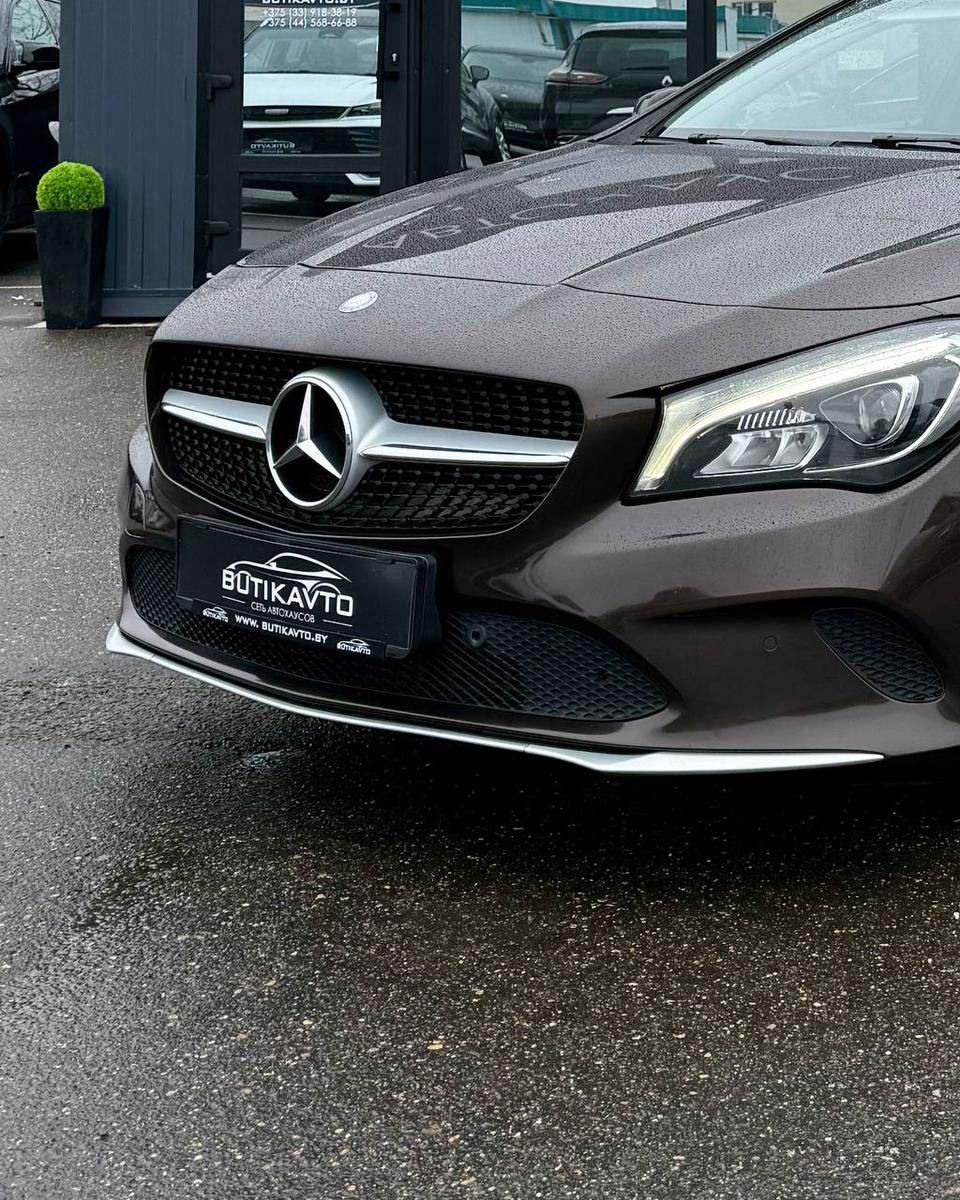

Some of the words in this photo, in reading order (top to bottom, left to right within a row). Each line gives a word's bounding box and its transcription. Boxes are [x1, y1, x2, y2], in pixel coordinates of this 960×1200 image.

[263, 8, 287, 17] +375
[289, 7, 307, 20] (33)
[310, 7, 357, 17] 918-38-19
[267, 18, 287, 27] 375
[289, 17, 307, 29] (44)
[310, 18, 358, 28] 568-66-88
[222, 568, 354, 617] BUTIKAVTO
[250, 601, 267, 613] СЕТЬ
[267, 604, 315, 623] АВТОХАУСОВ
[234, 614, 259, 629] WWW.
[261, 621, 329, 644] BUTIKAVTO.BY
